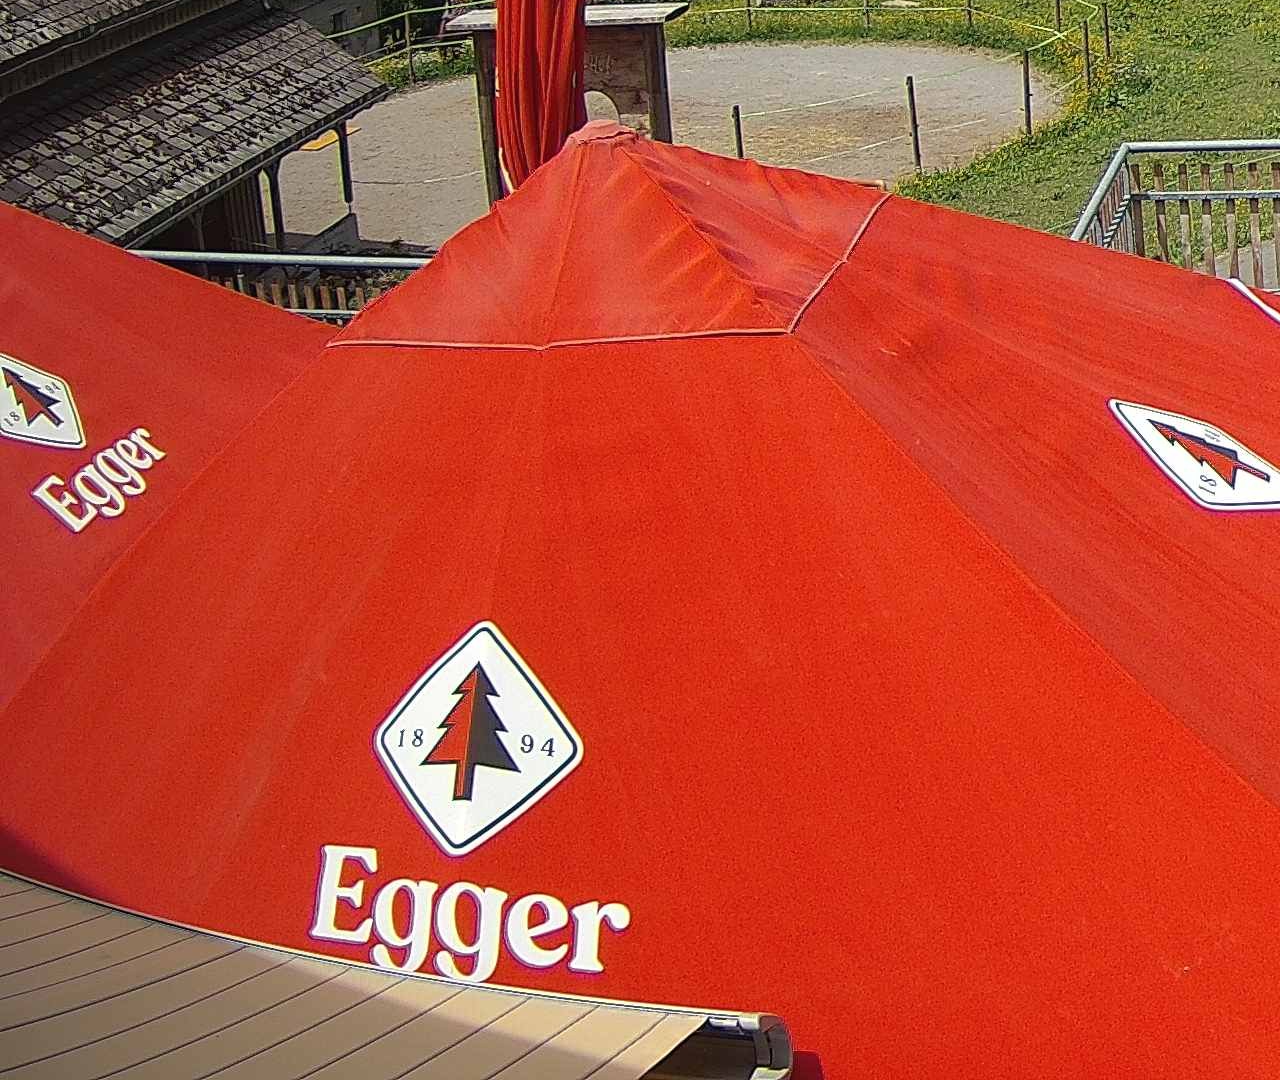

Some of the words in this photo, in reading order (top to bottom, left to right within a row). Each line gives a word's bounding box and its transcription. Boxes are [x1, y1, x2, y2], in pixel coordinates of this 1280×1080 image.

[31, 427, 167, 534] Egger
[396, 728, 424, 748] 18
[519, 733, 557, 758] 94
[308, 843, 632, 984] Egger
